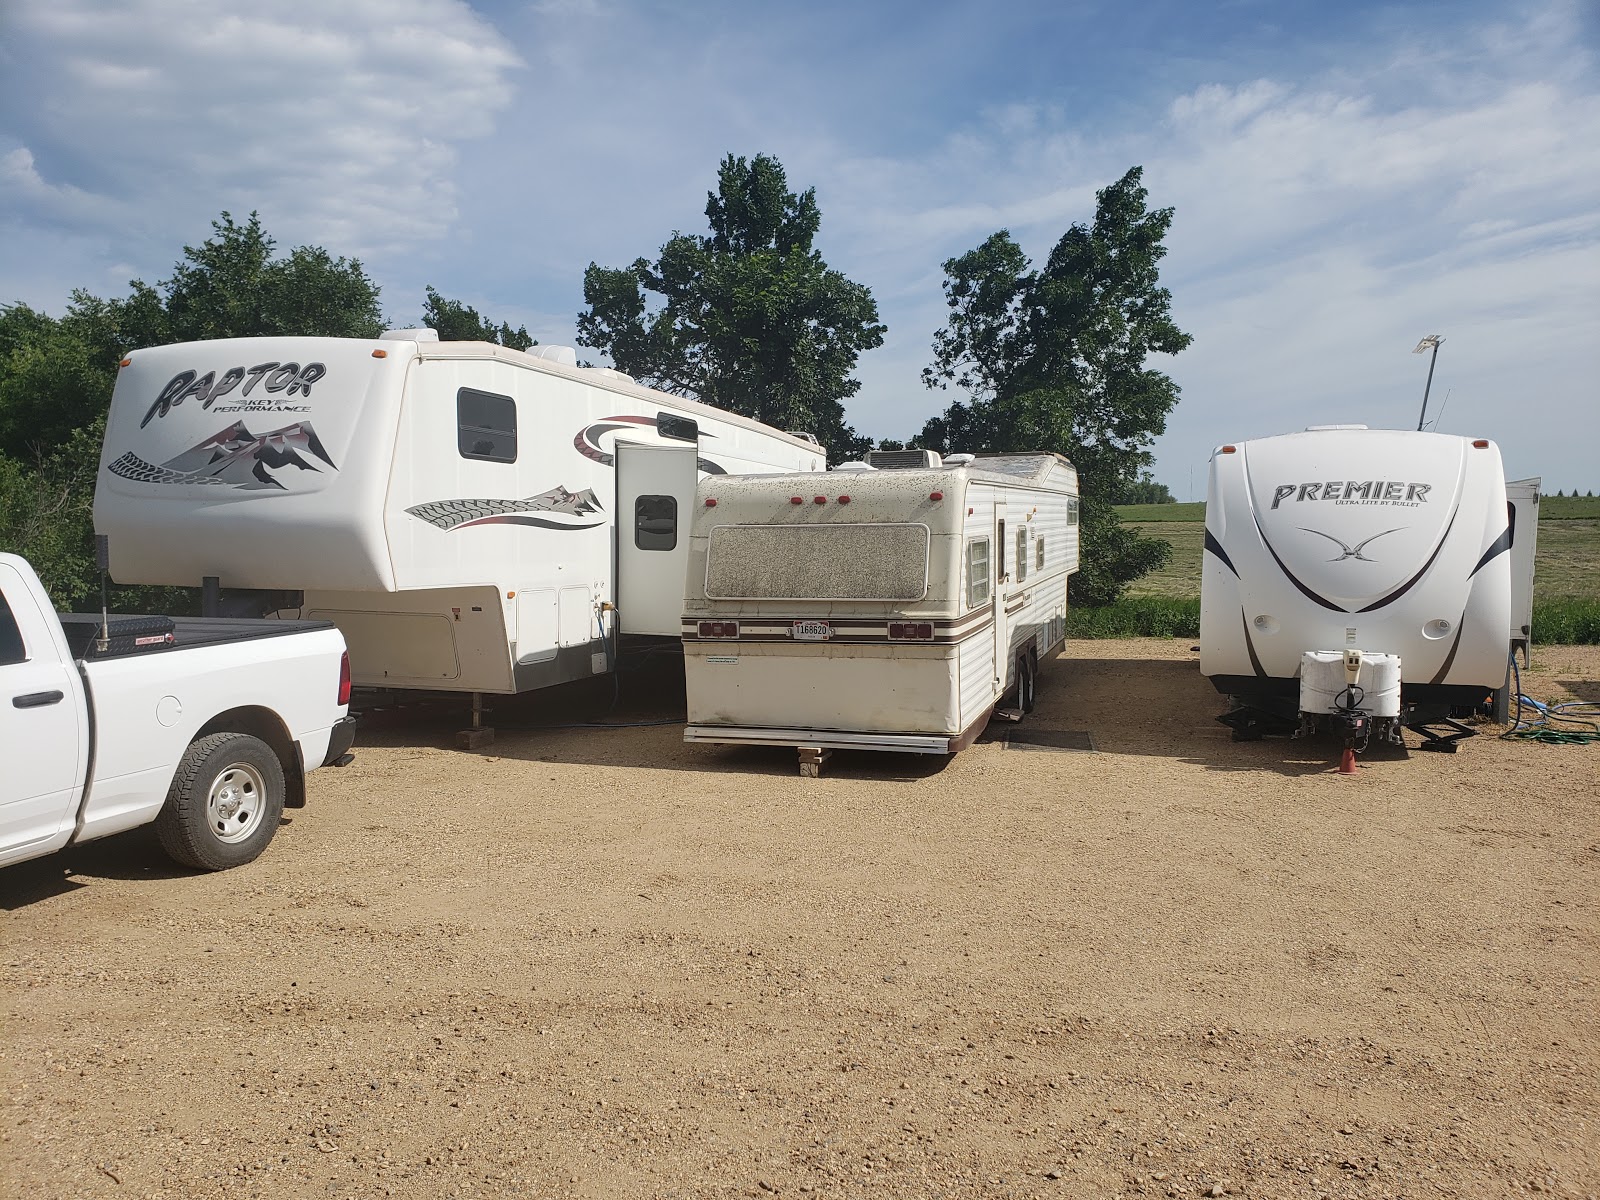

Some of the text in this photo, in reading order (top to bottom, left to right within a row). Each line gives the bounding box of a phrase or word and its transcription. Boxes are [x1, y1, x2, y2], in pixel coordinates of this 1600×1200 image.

[140, 362, 327, 430] RAPTOR
[212, 405, 312, 413] PERFORMANCE
[1270, 480, 1432, 510] PREMIER
[1391, 500, 1420, 508] BULLET
